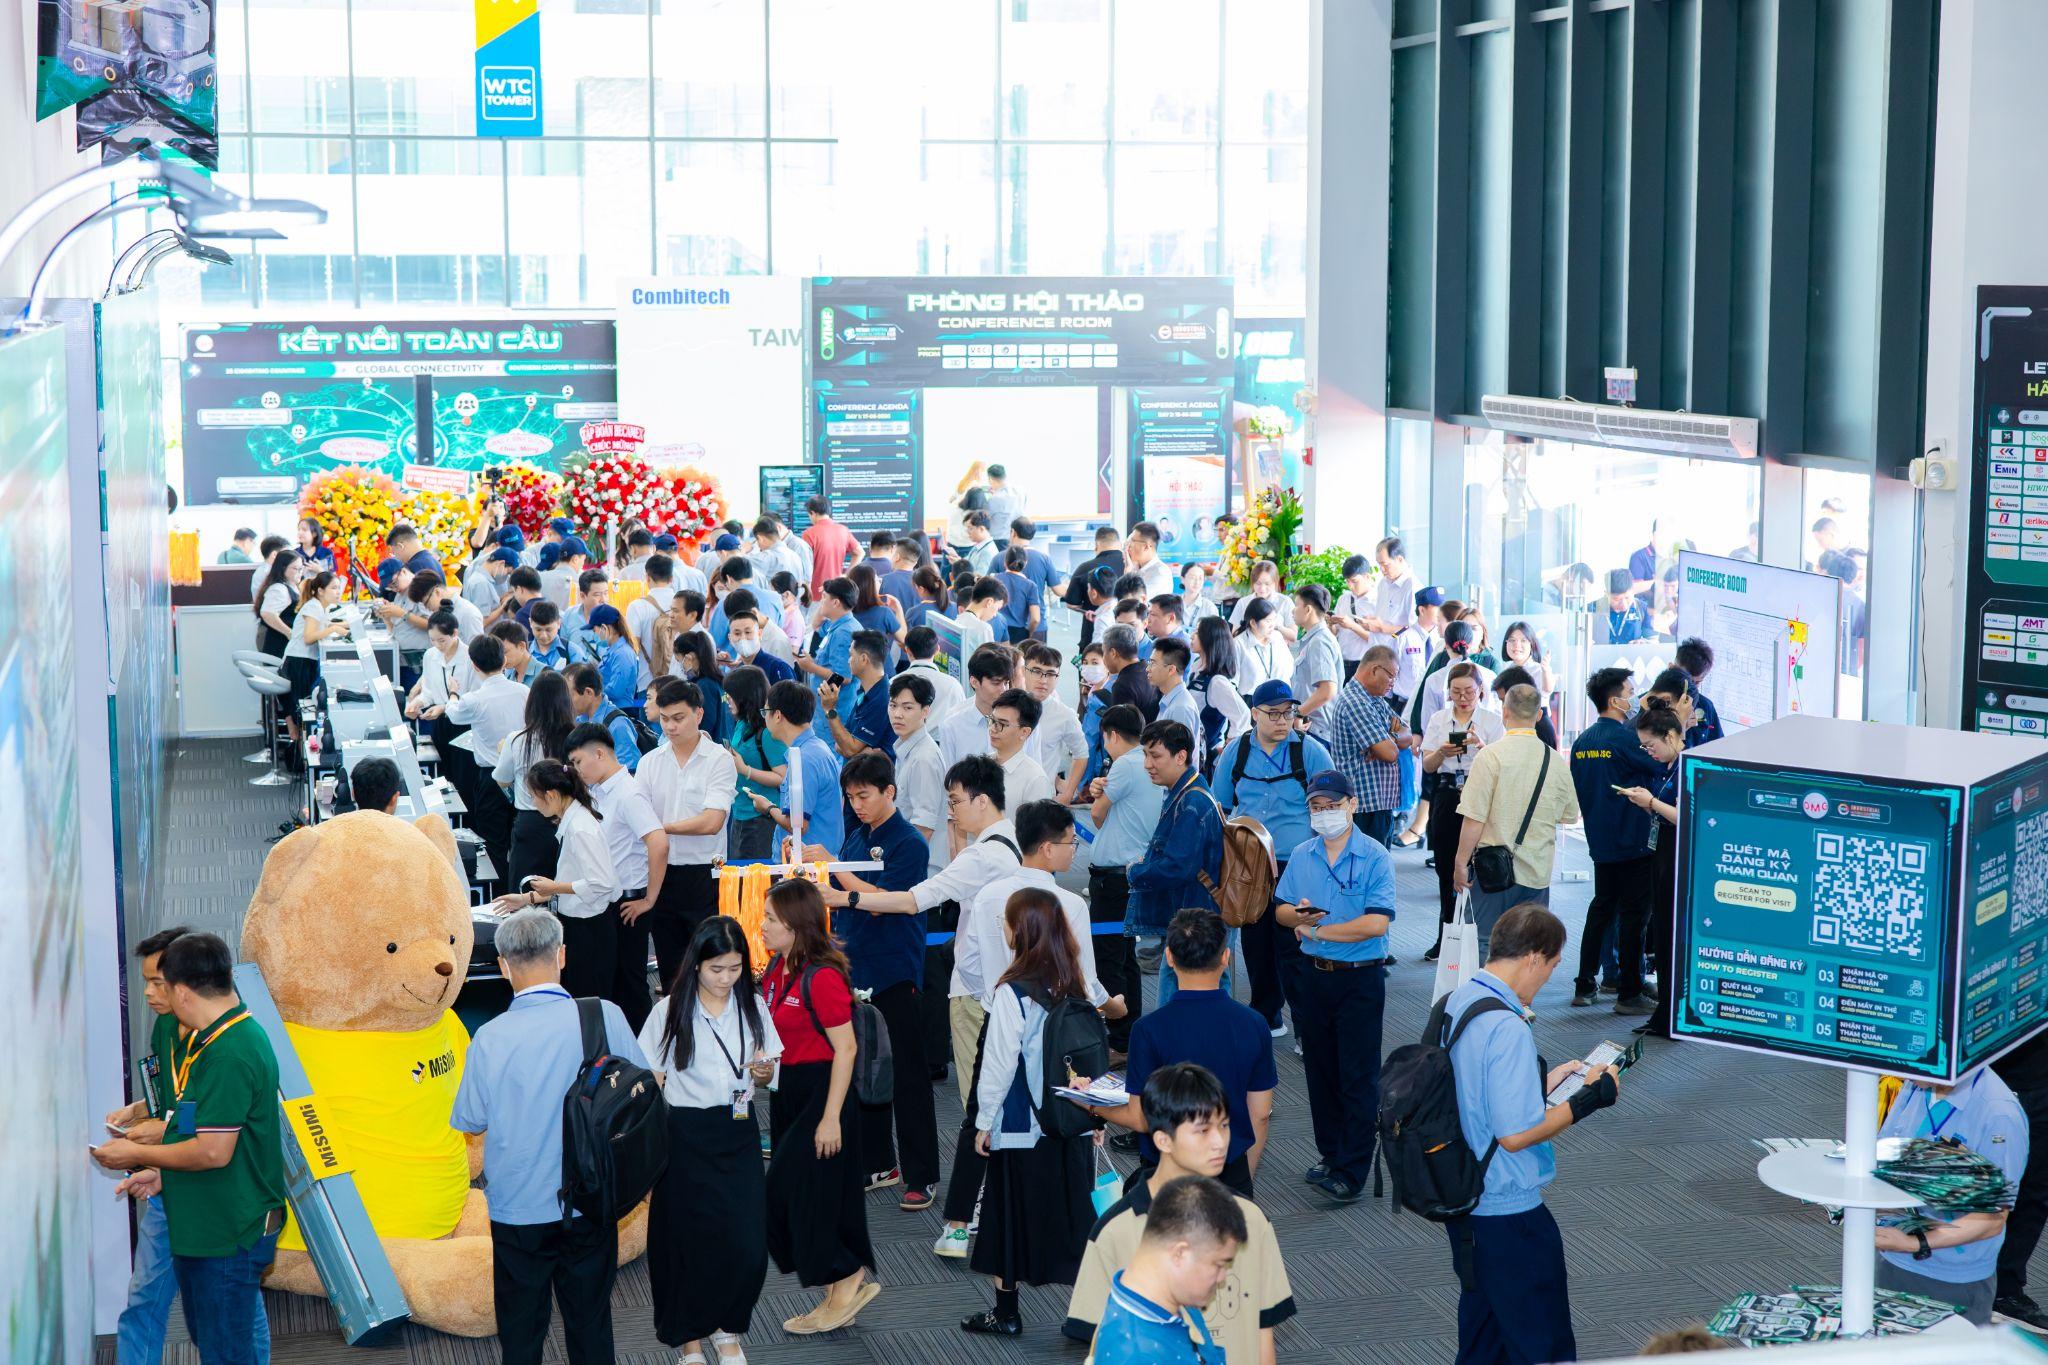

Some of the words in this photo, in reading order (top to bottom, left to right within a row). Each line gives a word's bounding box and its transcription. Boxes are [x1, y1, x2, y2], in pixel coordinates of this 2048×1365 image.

[485, 78, 532, 94] WTC
[485, 95, 532, 106] TOWER
[632, 288, 730, 305] Combitech
[908, 290, 1006, 312] PHÒNG
[1013, 289, 1059, 315] HỘI
[1066, 289, 1144, 312] THẢO
[938, 317, 1055, 328] CONFERENCE
[1060, 317, 1112, 328] ROOM
[355, 365, 400, 373] GLOBAL
[403, 364, 485, 373] CONNECTIVITY
[1995, 464, 2018, 474] EMIN
[1686, 566, 1726, 589] CONFERENCE
[1726, 575, 1747, 594] ROOM
[1723, 843, 1763, 856] QUÉT
[1767, 848, 1791, 860] MÃ
[1769, 860, 1791, 871] KÝ
[1715, 863, 1755, 878] THAM
[1757, 869, 1798, 883] QUAN
[1739, 886, 1759, 895] SCAN
[1762, 889, 1772, 897] TO
[1717, 891, 1753, 901] REGISTER
[1755, 896, 1770, 904] FOR
[1772, 899, 1791, 908] VISIT
[1698, 946, 1734, 960] HƯỚNG
[1736, 949, 1757, 964] DẪN
[1760, 954, 1787, 969] ĐĂNG
[1789, 958, 1804, 971] KÝ
[1697, 962, 1720, 971] HOW
[1722, 965, 1734, 973] TO
[1735, 967, 1778, 980] REGISTER
[1818, 969, 1834, 983] 03
[1877, 973, 1889, 981] QR
[1700, 979, 1715, 992] 01
[1721, 981, 1740, 990] QUÉT
[1753, 986, 1764, 994] QR
[1699, 1002, 1714, 1015] 02
[1819, 996, 1835, 1009] 04
[1857, 1001, 1873, 1010] MÁY
[1741, 1008, 1766, 1018] THÔNG
[1766, 1012, 1778, 1020] TIN
[1816, 1023, 1832, 1036] 05
[1840, 1029, 1861, 1038] THAM
[1861, 1033, 1883, 1041] QUAN
[299, 1103, 338, 1168] MiSUMi
